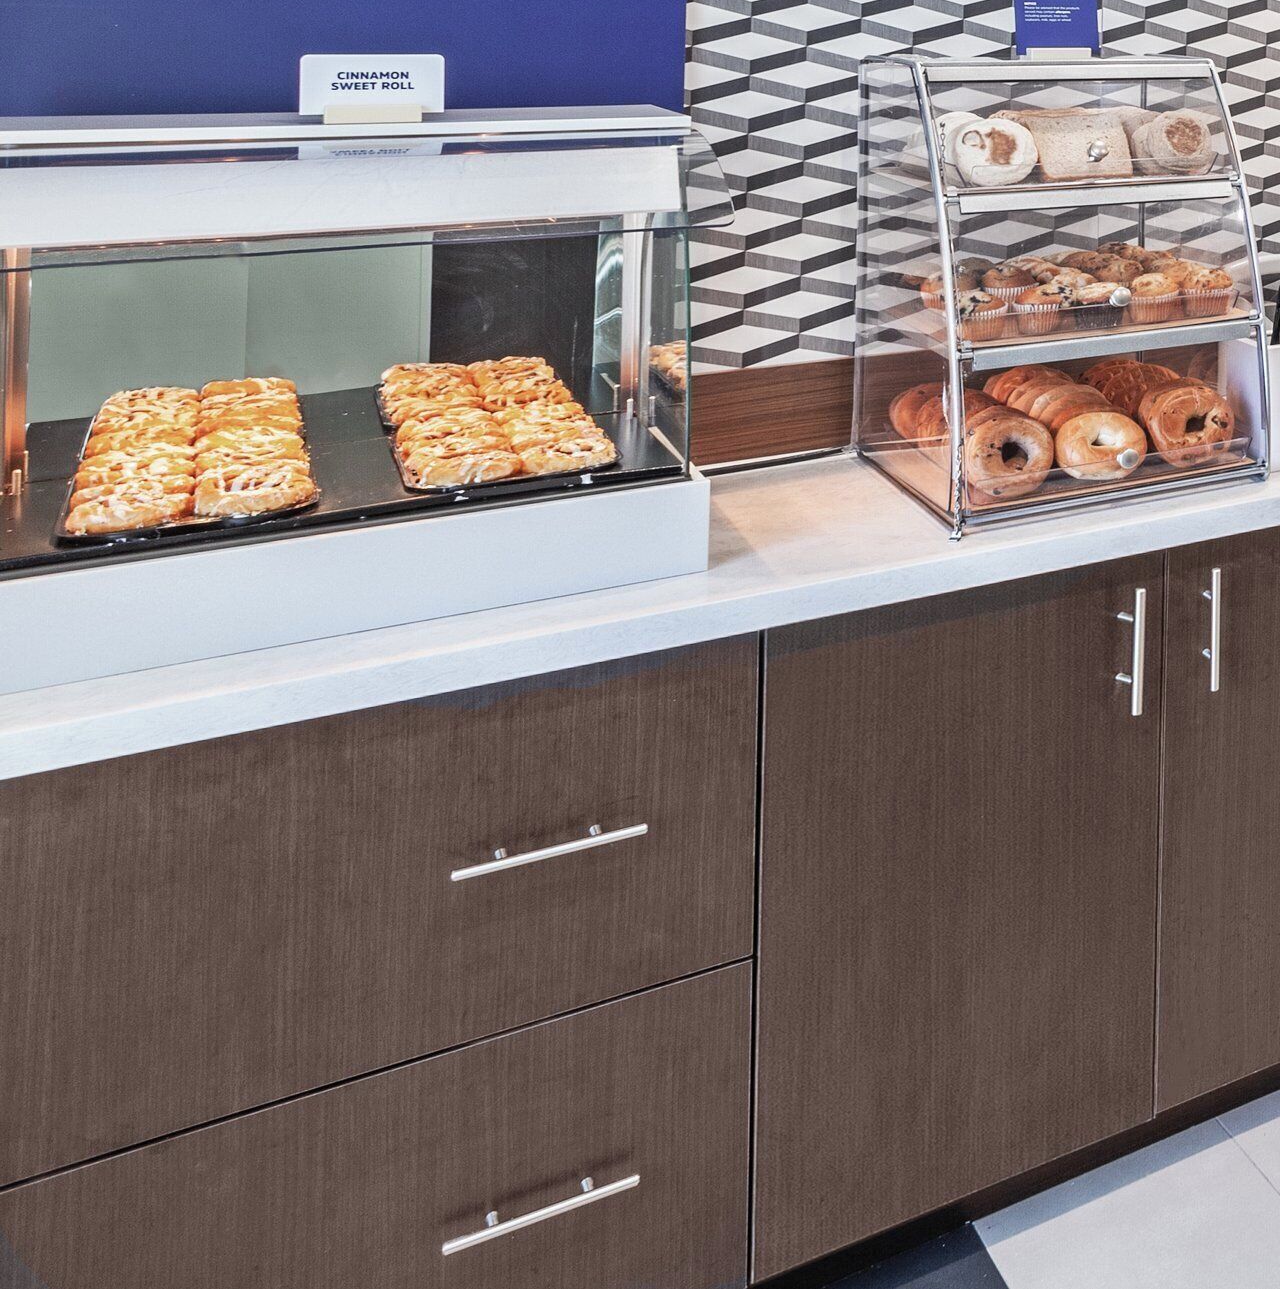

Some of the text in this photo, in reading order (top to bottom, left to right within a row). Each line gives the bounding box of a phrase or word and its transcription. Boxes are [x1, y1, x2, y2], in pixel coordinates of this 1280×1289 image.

[337, 71, 409, 80] CINNAMON
[331, 81, 415, 91] SWEET ROLL
